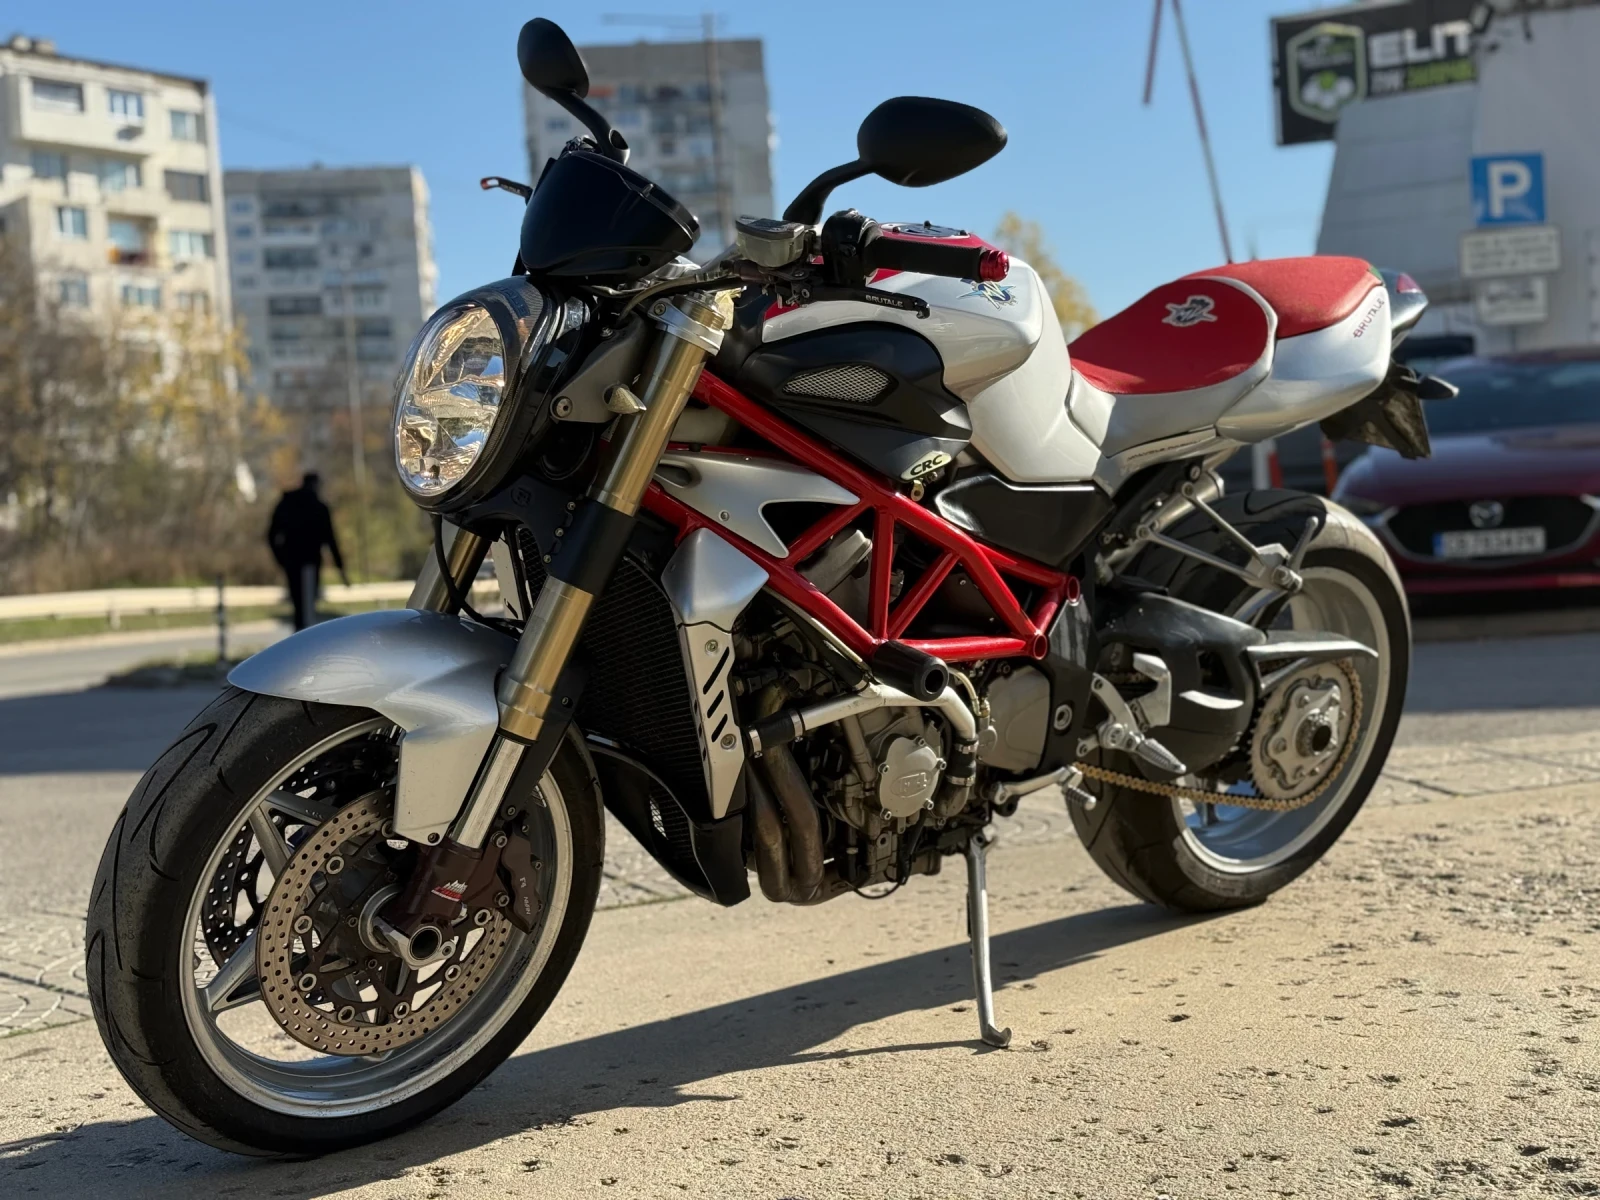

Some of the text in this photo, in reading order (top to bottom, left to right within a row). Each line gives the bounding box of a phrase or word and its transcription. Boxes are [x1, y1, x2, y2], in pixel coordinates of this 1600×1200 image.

[1488, 160, 1532, 218] P
[865, 294, 904, 308] BRUTALE
[1353, 298, 1385, 338] BRUTALE
[910, 454, 943, 476] CRC
